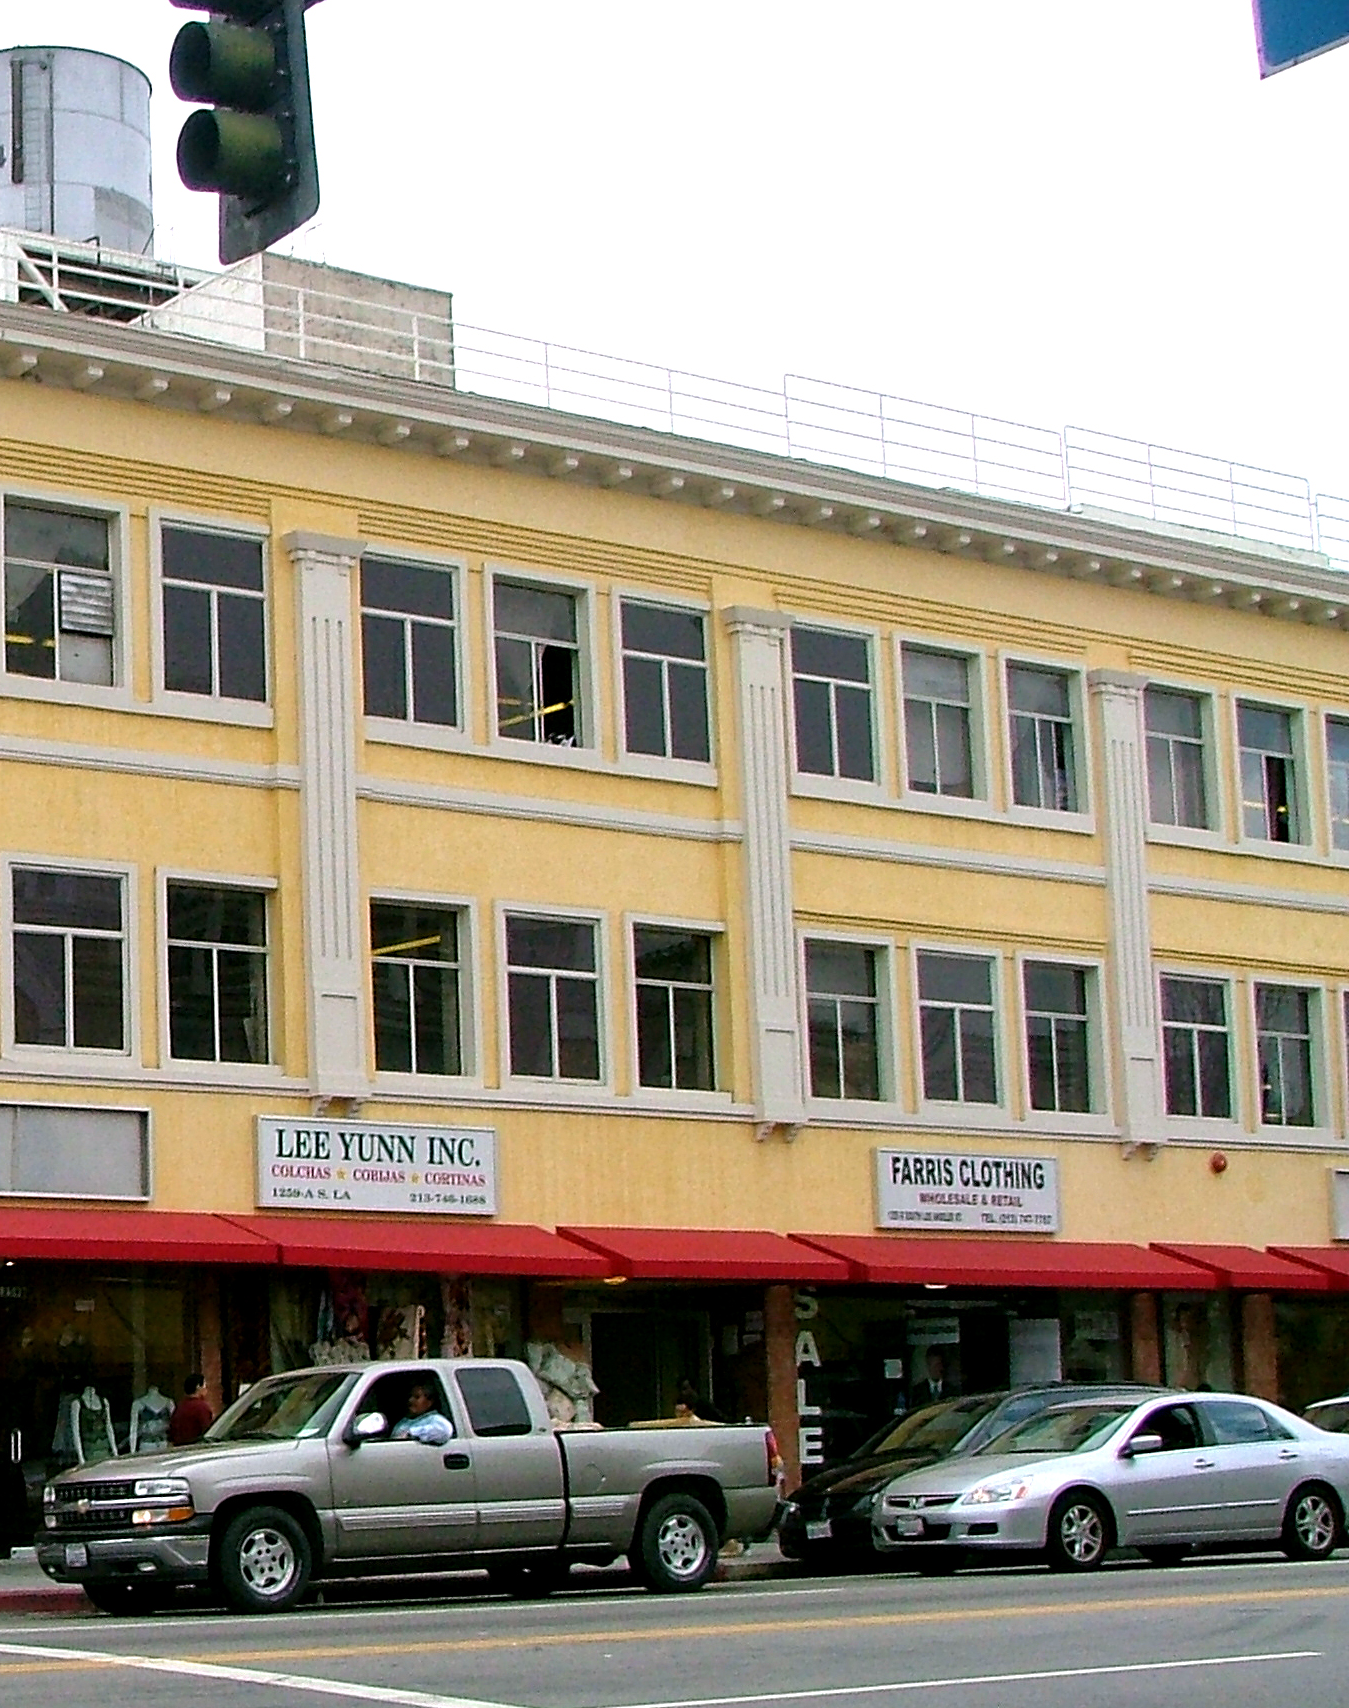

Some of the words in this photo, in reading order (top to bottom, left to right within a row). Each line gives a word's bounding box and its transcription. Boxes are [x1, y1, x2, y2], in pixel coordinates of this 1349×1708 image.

[275, 1128, 331, 1160] LEE
[338, 1131, 416, 1164] YUNN
[427, 1136, 481, 1167] INC.
[271, 1163, 331, 1180] COLCHAS
[352, 1167, 406, 1184] COBIJAS
[424, 1171, 486, 1187] CORTINAS
[891, 1156, 953, 1186] FARRIS
[959, 1159, 1045, 1190] CLOTHING
[333, 1189, 351, 1201] LA
[919, 1192, 978, 1206] WHOLESALE
[991, 1194, 1023, 1208] RETAIL
[794, 1286, 825, 1464] SALE
